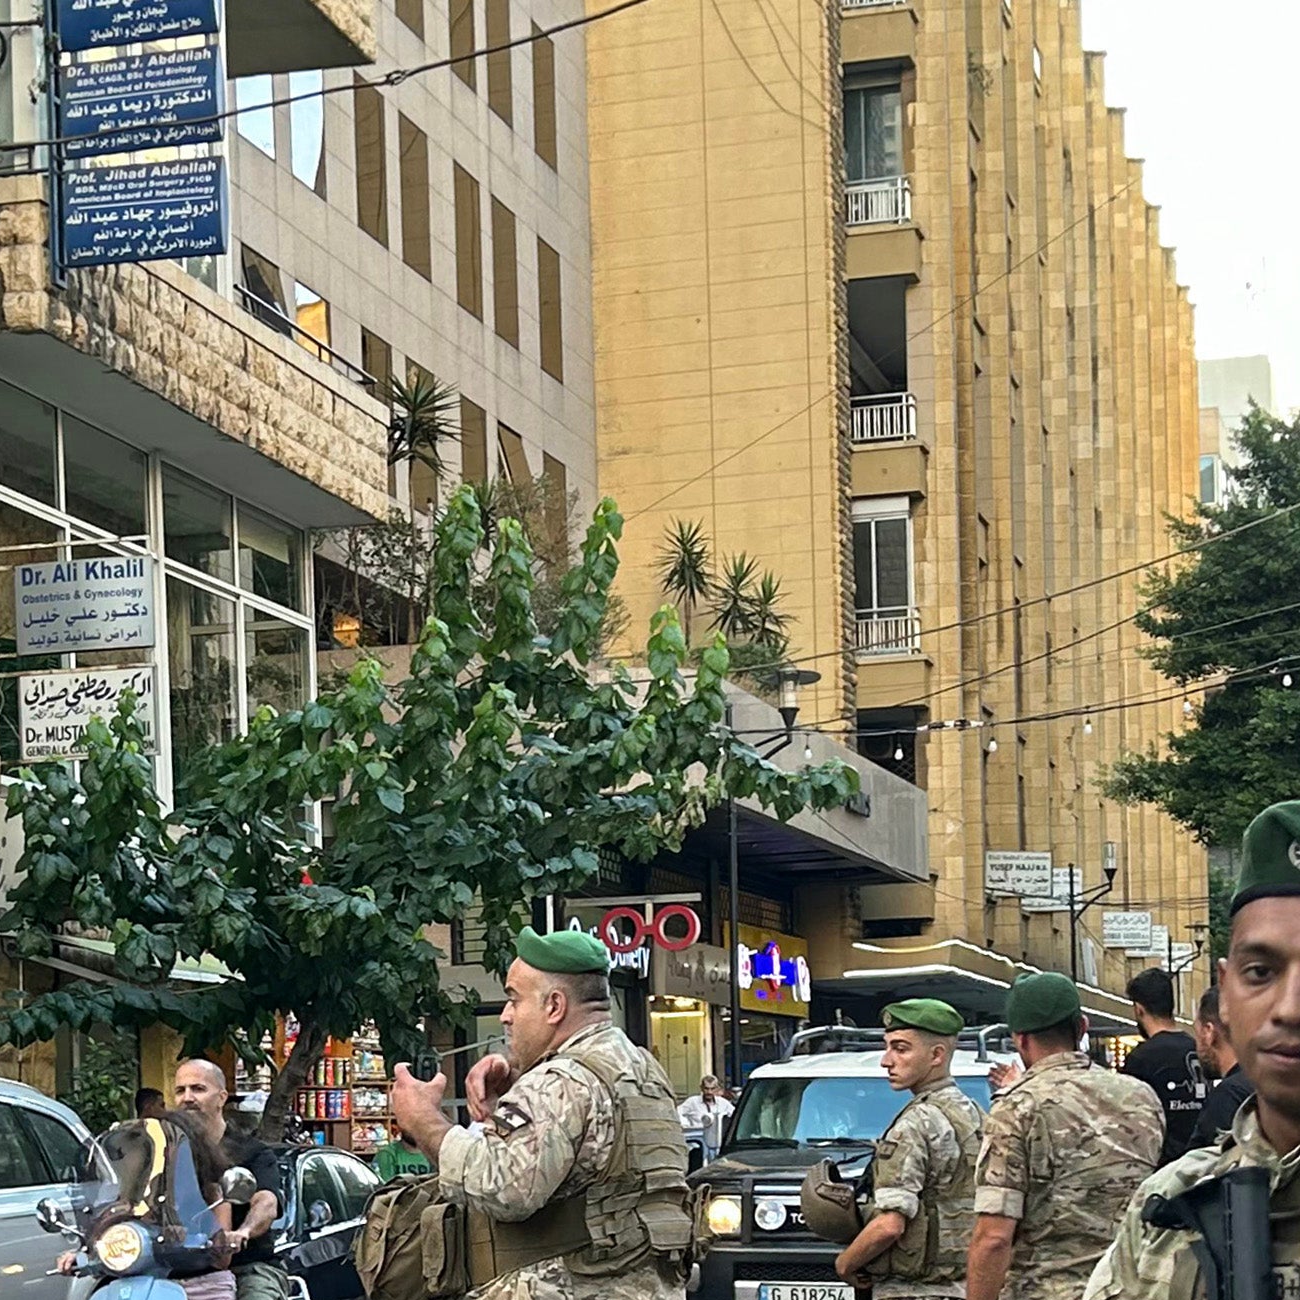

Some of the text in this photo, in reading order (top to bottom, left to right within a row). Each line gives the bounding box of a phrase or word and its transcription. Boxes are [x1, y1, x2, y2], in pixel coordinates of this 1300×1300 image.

[66, 49, 212, 78] Dr. Rima J. Abdallah
[145, 69, 164, 79] Oral
[65, 74, 208, 99] American Board of Periodontology
[66, 89, 212, 118] الدكتورة ريما عبد الله
[68, 160, 217, 184] Prof. Jihad Abdallah
[127, 179, 146, 190] Oral
[148, 176, 184, 188] Surgery
[69, 185, 216, 205] American Board of Implantology
[66, 200, 219, 226] البروفيسور جهاد عبد الله
[93, 230, 114, 242] الفم
[145, 225, 158, 240] في
[137, 241, 148, 256] في
[21, 559, 144, 586] Dr. Ali Khalil
[22, 587, 144, 604] Obstetrics & Gynecology
[23, 602, 149, 629] دكتور علي خليل
[46, 725, 86, 742] MUSTA
